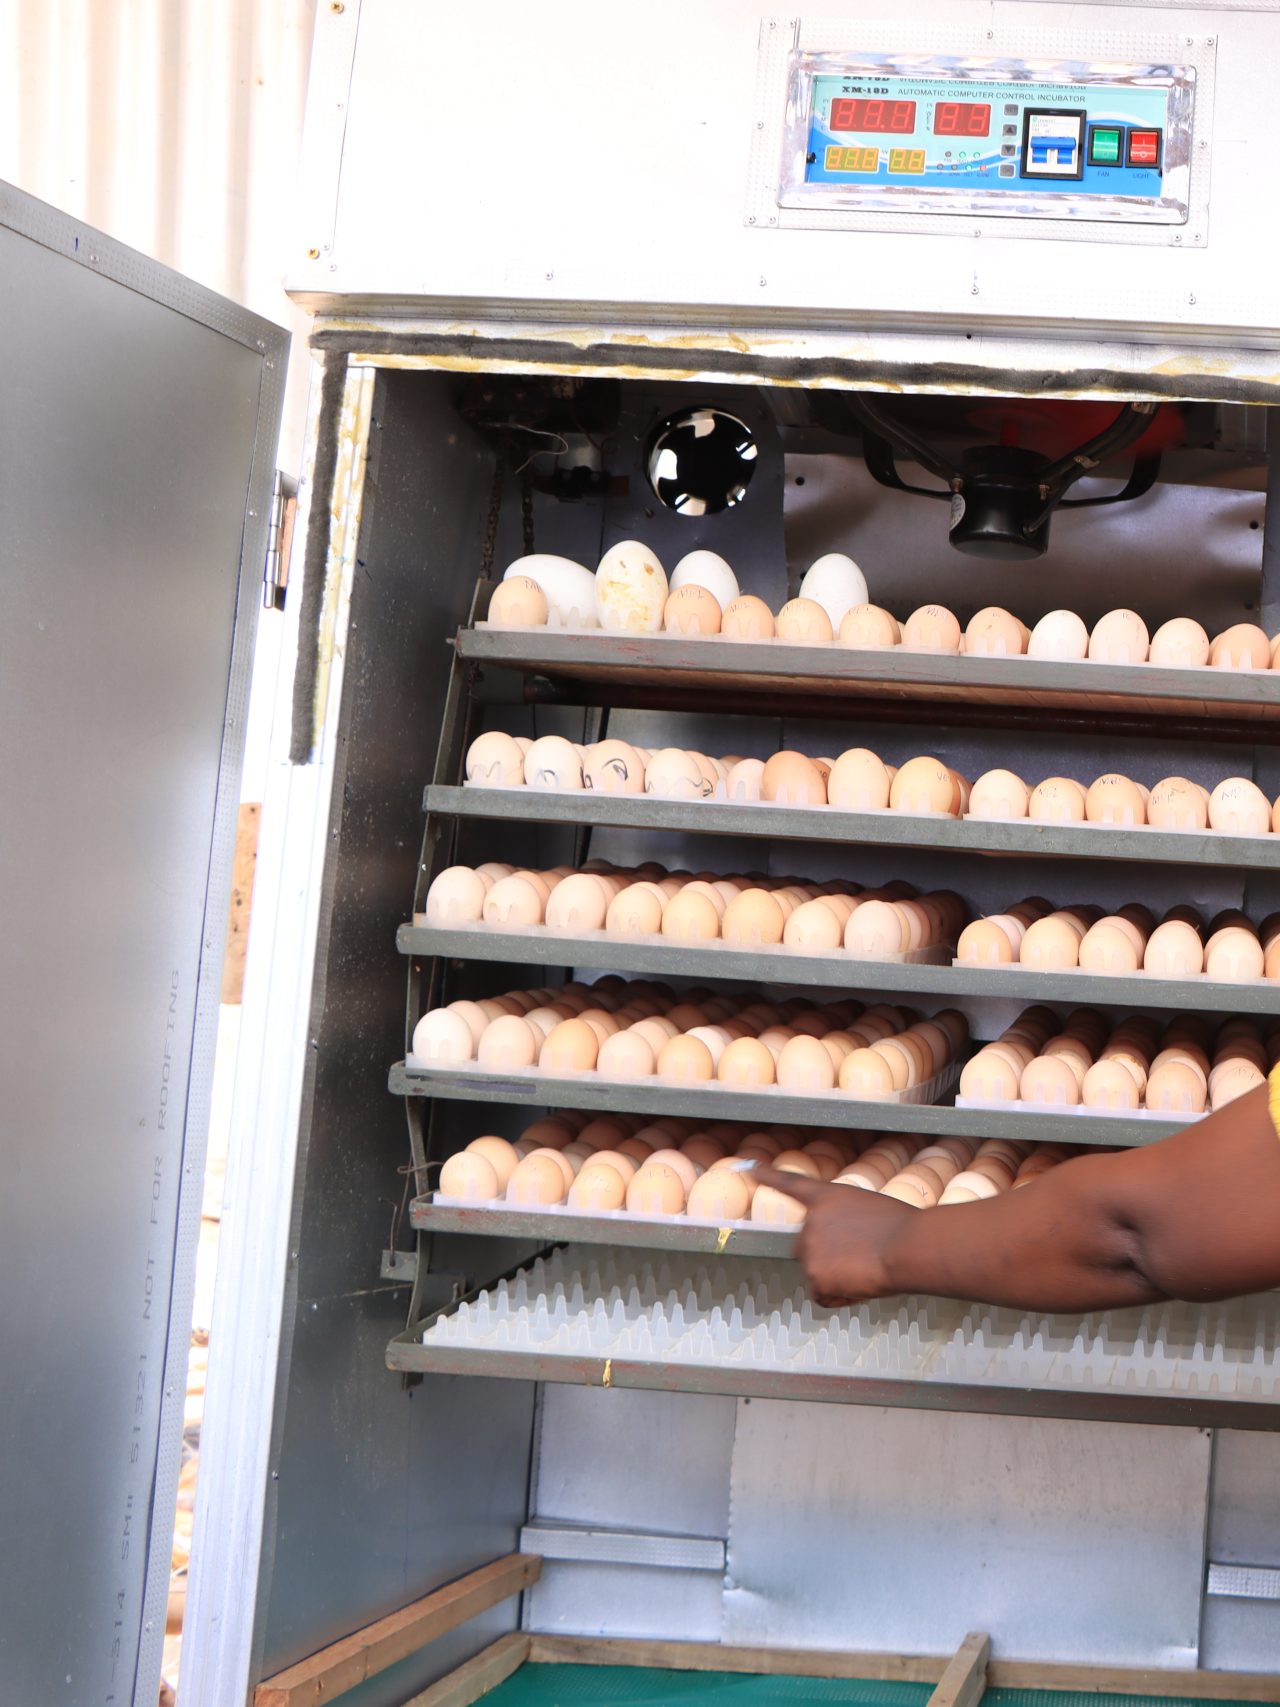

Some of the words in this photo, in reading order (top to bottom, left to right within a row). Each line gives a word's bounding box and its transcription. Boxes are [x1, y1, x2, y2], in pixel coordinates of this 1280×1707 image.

[898, 88, 945, 97] AUTOMATIC
[947, 90, 993, 99] COMPUTER
[996, 92, 1034, 100] CONTROL
[1037, 94, 1086, 103] INCUBATOR
[142, 1251, 155, 1320] NOT
[150, 1155, 163, 1224] FOR
[157, 969, 179, 1131] ROOFING
